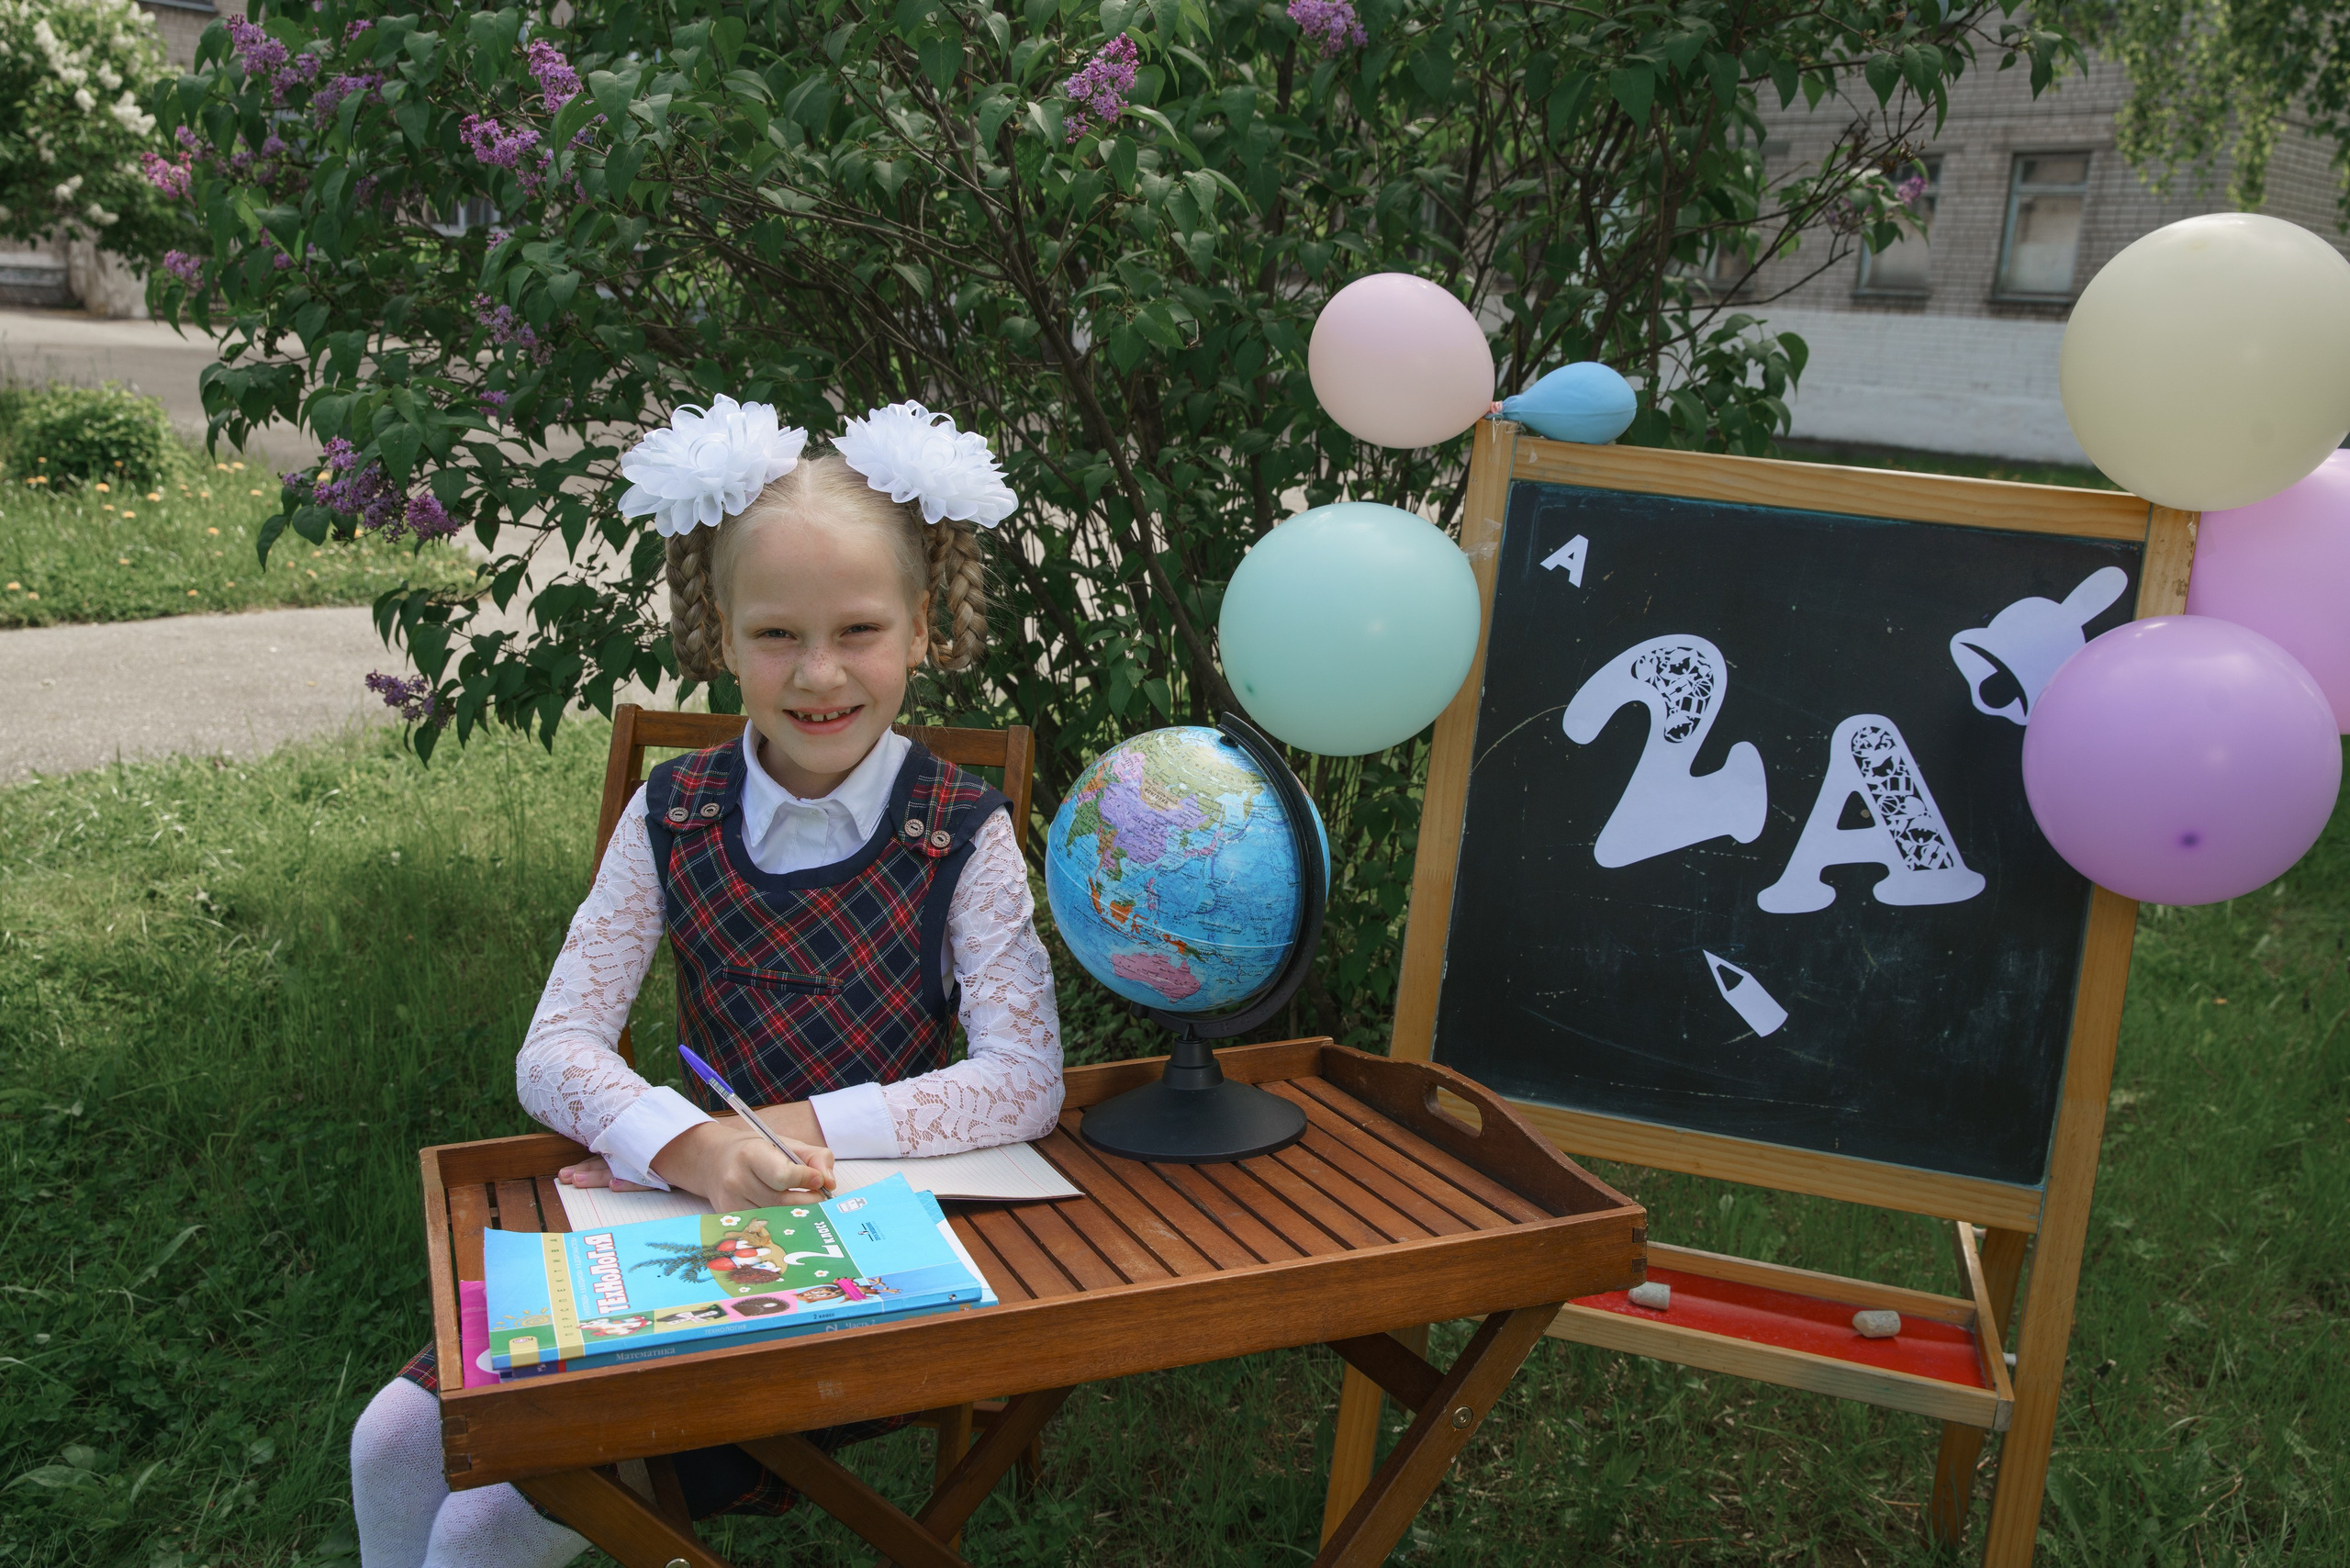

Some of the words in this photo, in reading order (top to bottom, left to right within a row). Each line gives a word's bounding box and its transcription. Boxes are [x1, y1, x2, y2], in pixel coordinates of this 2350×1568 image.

[783, 1244, 845, 1265] 2
[549, 1238, 574, 1337] ПЕРСПЕКТИВА
[704, 1323, 747, 1336] ТЕХНОЛОГИЯ
[818, 1311, 835, 1319] класс
[615, 1346, 676, 1361] Математика
